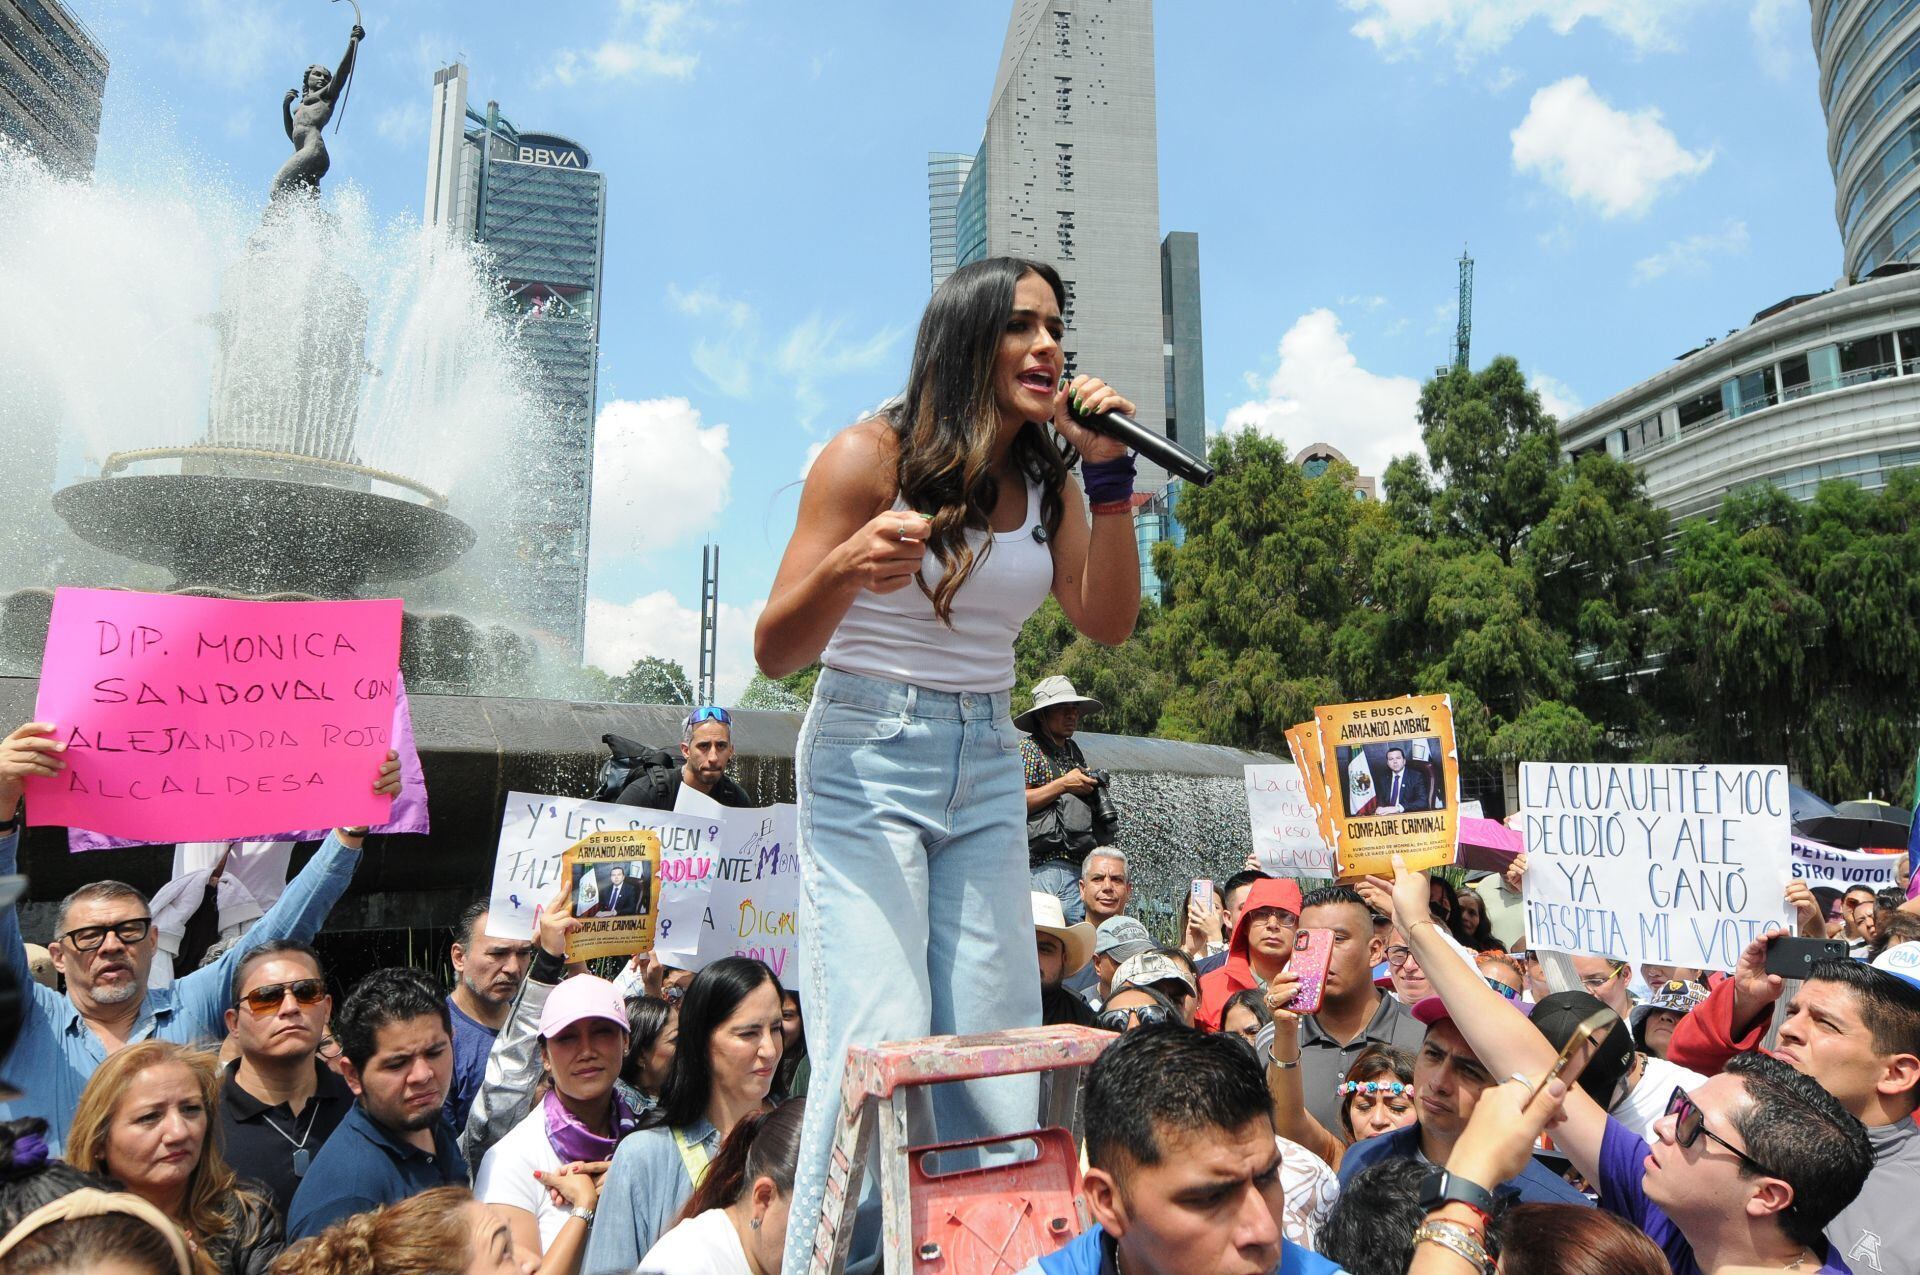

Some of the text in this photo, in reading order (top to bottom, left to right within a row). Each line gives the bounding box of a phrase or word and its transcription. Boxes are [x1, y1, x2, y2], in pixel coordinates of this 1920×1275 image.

[519, 146, 581, 167] BBVA
[197, 631, 356, 664] MONICA
[92, 677, 393, 706] SANDOVAL CON
[1353, 706, 1414, 720] SE BUSCA
[65, 724, 300, 756] ALEJANDRA
[1340, 714, 1432, 741] ARMANDO AMBRÍZ
[69, 770, 324, 801] ALCALDESA
[527, 803, 544, 839] Y
[761, 817, 774, 837] EL
[1347, 814, 1447, 841] COMPADRE CRIMINAL
[578, 842, 646, 859] ARMANDO AMBRÍZ
[603, 835, 635, 843] BUSCA
[1527, 811, 1743, 866] DECIDIÓ Y ALE
[716, 857, 753, 883] NTE
[1792, 862, 1892, 883] STRO VOTO!
[1557, 862, 1748, 914] YA GANÓ
[611, 918, 647, 932] CRIMINAL
[702, 906, 716, 930] A
[1639, 912, 1672, 962] MI
[1892, 950, 1919, 964] PAN
